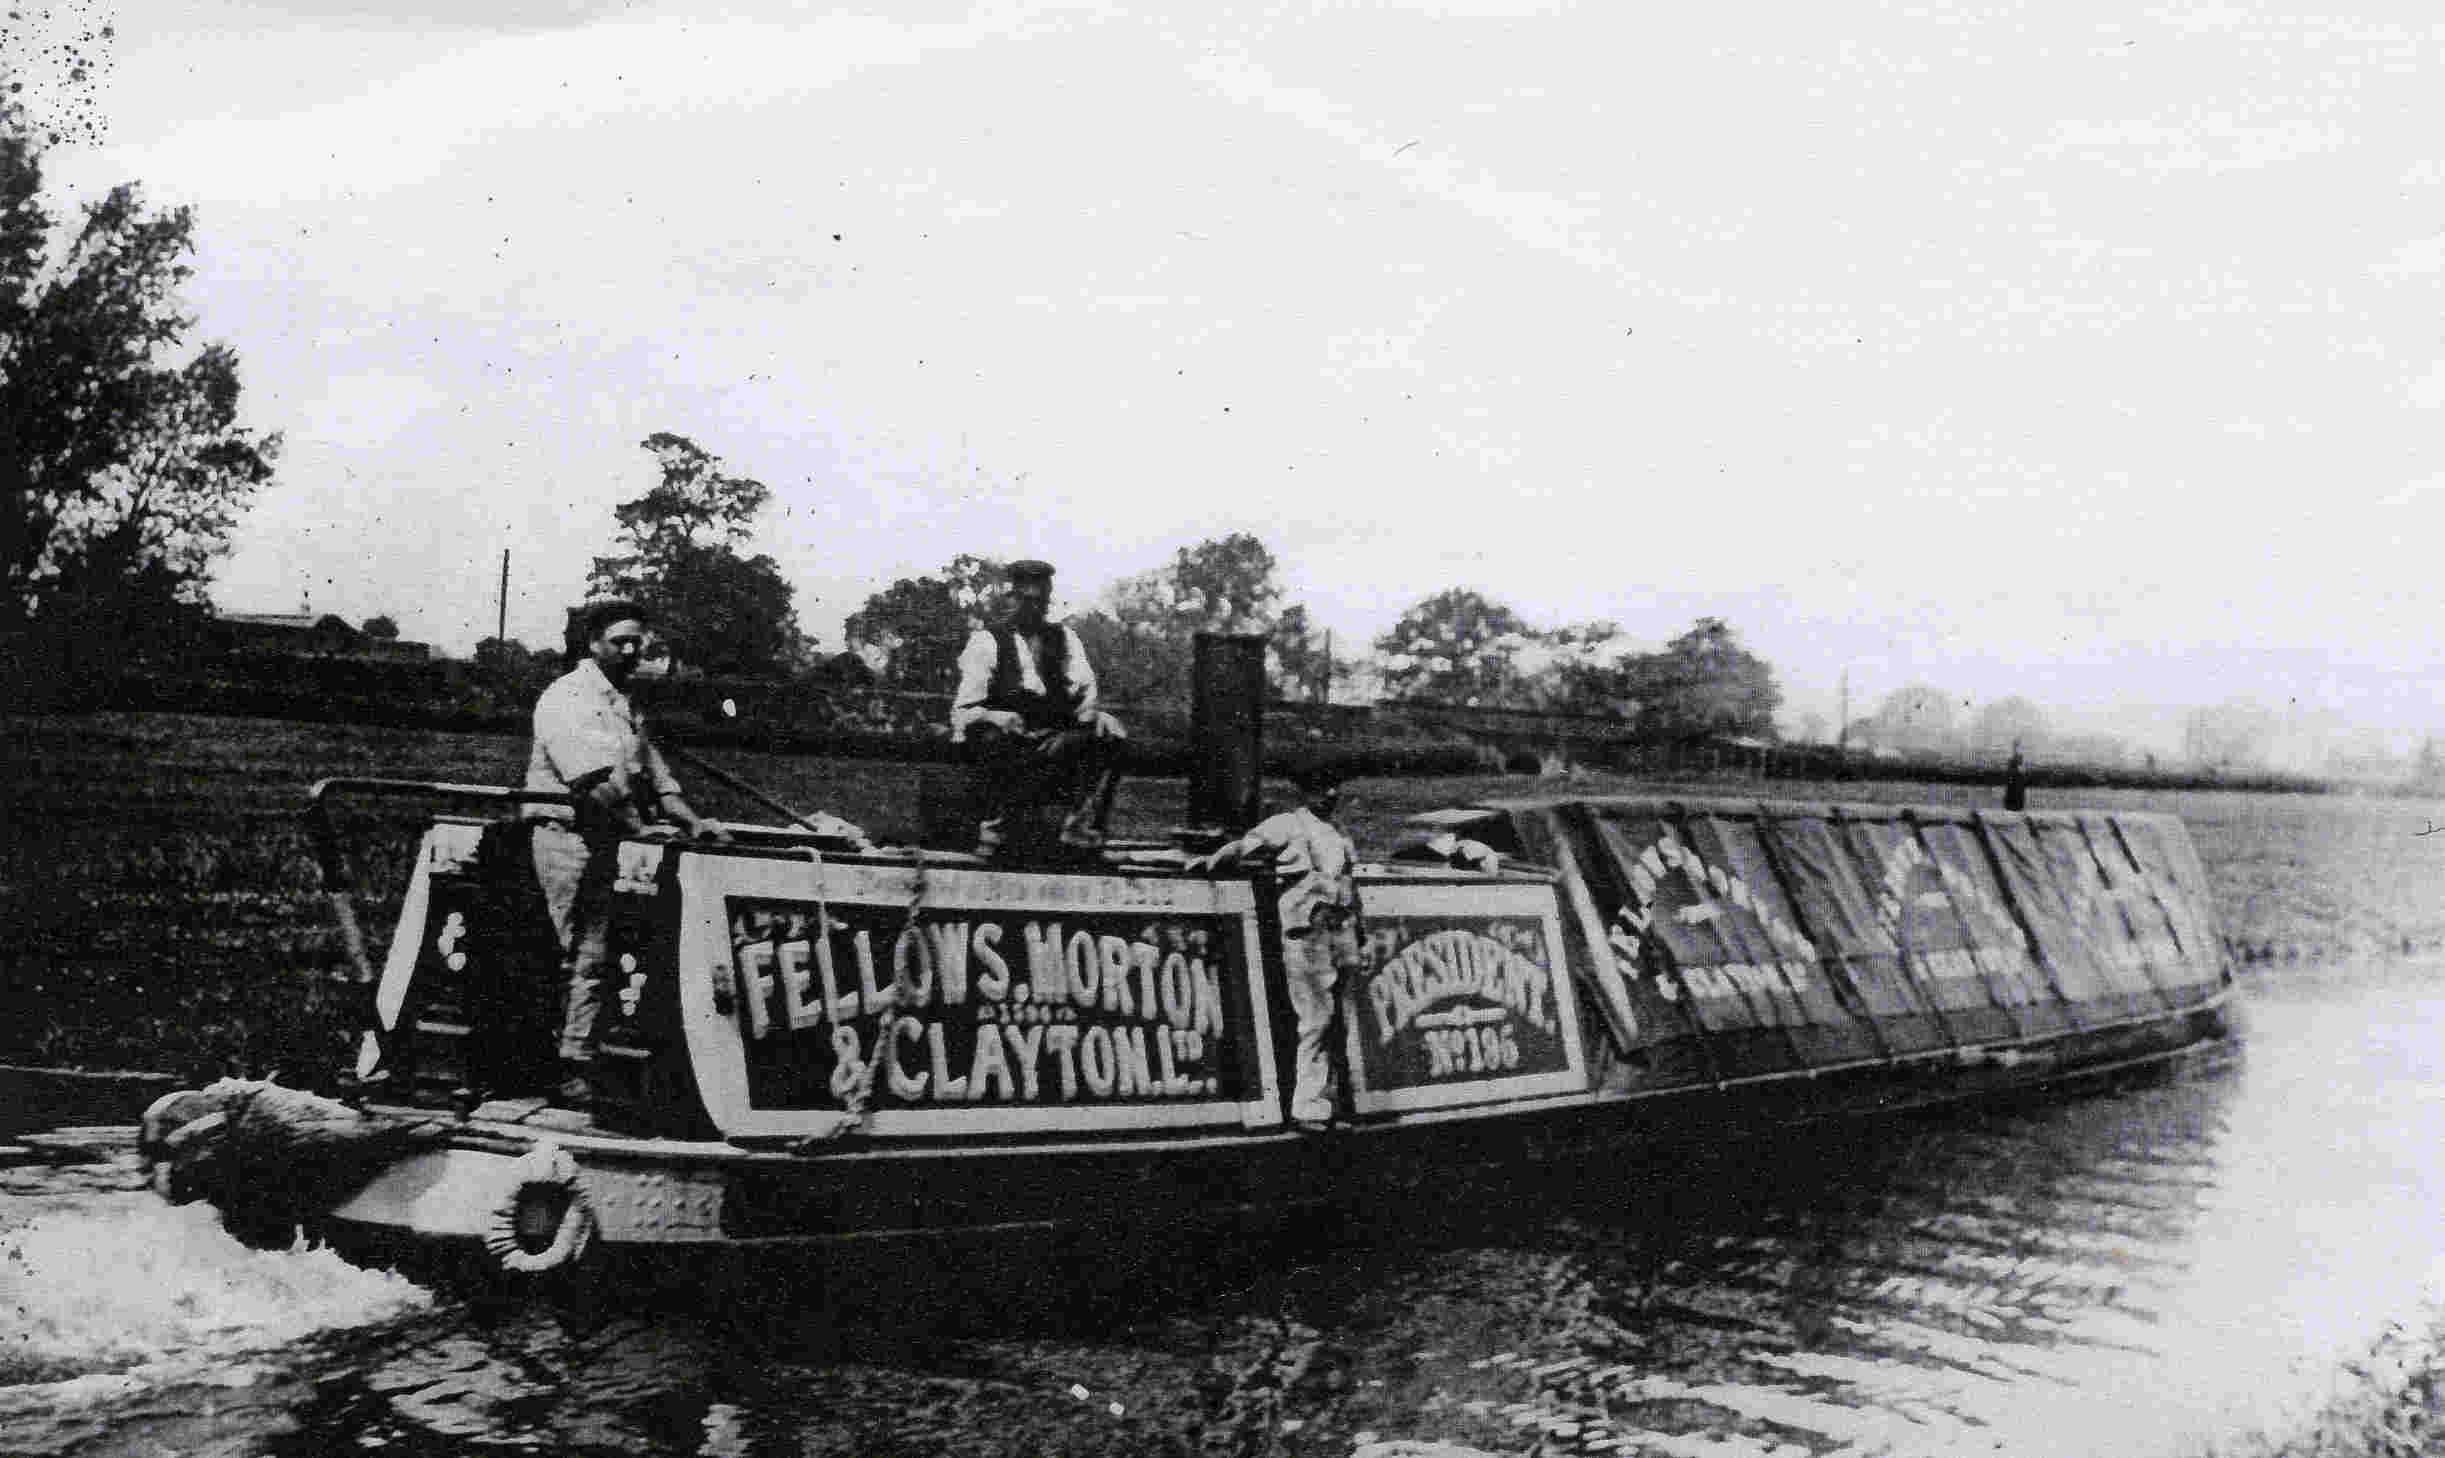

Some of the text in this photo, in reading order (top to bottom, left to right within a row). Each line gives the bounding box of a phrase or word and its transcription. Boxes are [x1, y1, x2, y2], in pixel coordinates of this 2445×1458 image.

[1024, 921, 1224, 1039] MORTON
[1368, 929, 1549, 1045] PRESIDENT
[831, 1025, 866, 1098] &
